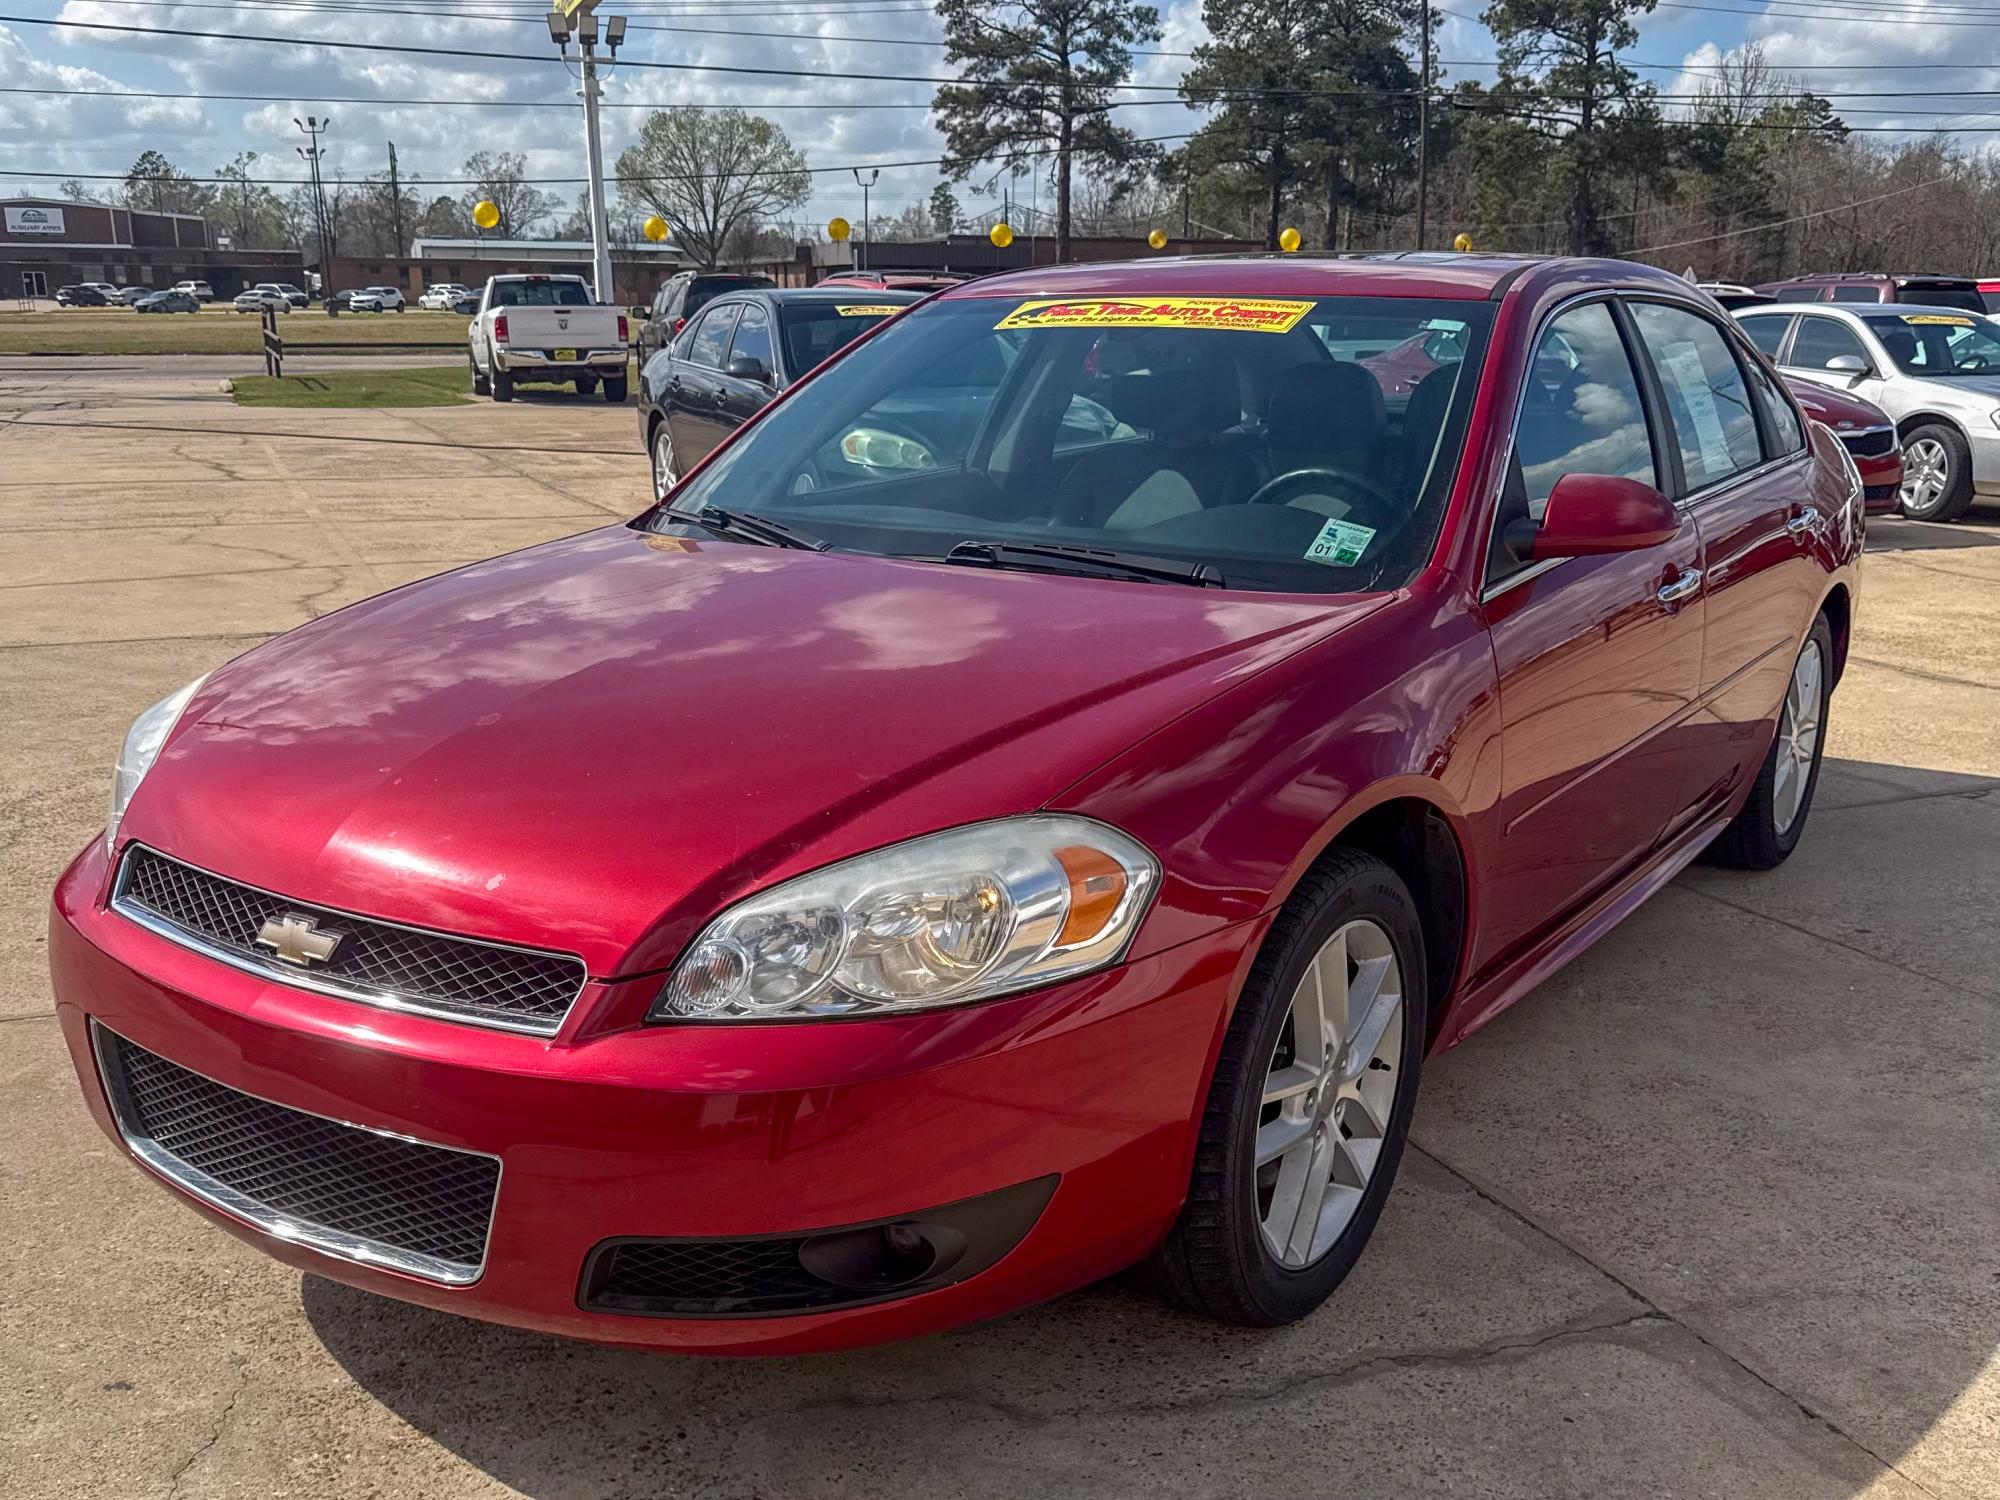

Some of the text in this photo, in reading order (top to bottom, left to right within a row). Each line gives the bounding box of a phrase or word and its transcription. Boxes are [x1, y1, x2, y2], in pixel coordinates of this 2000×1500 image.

[1229, 301, 1304, 309] PROTECTION
[1255, 318, 1286, 326] MILE
[1314, 543, 1332, 556] 01
